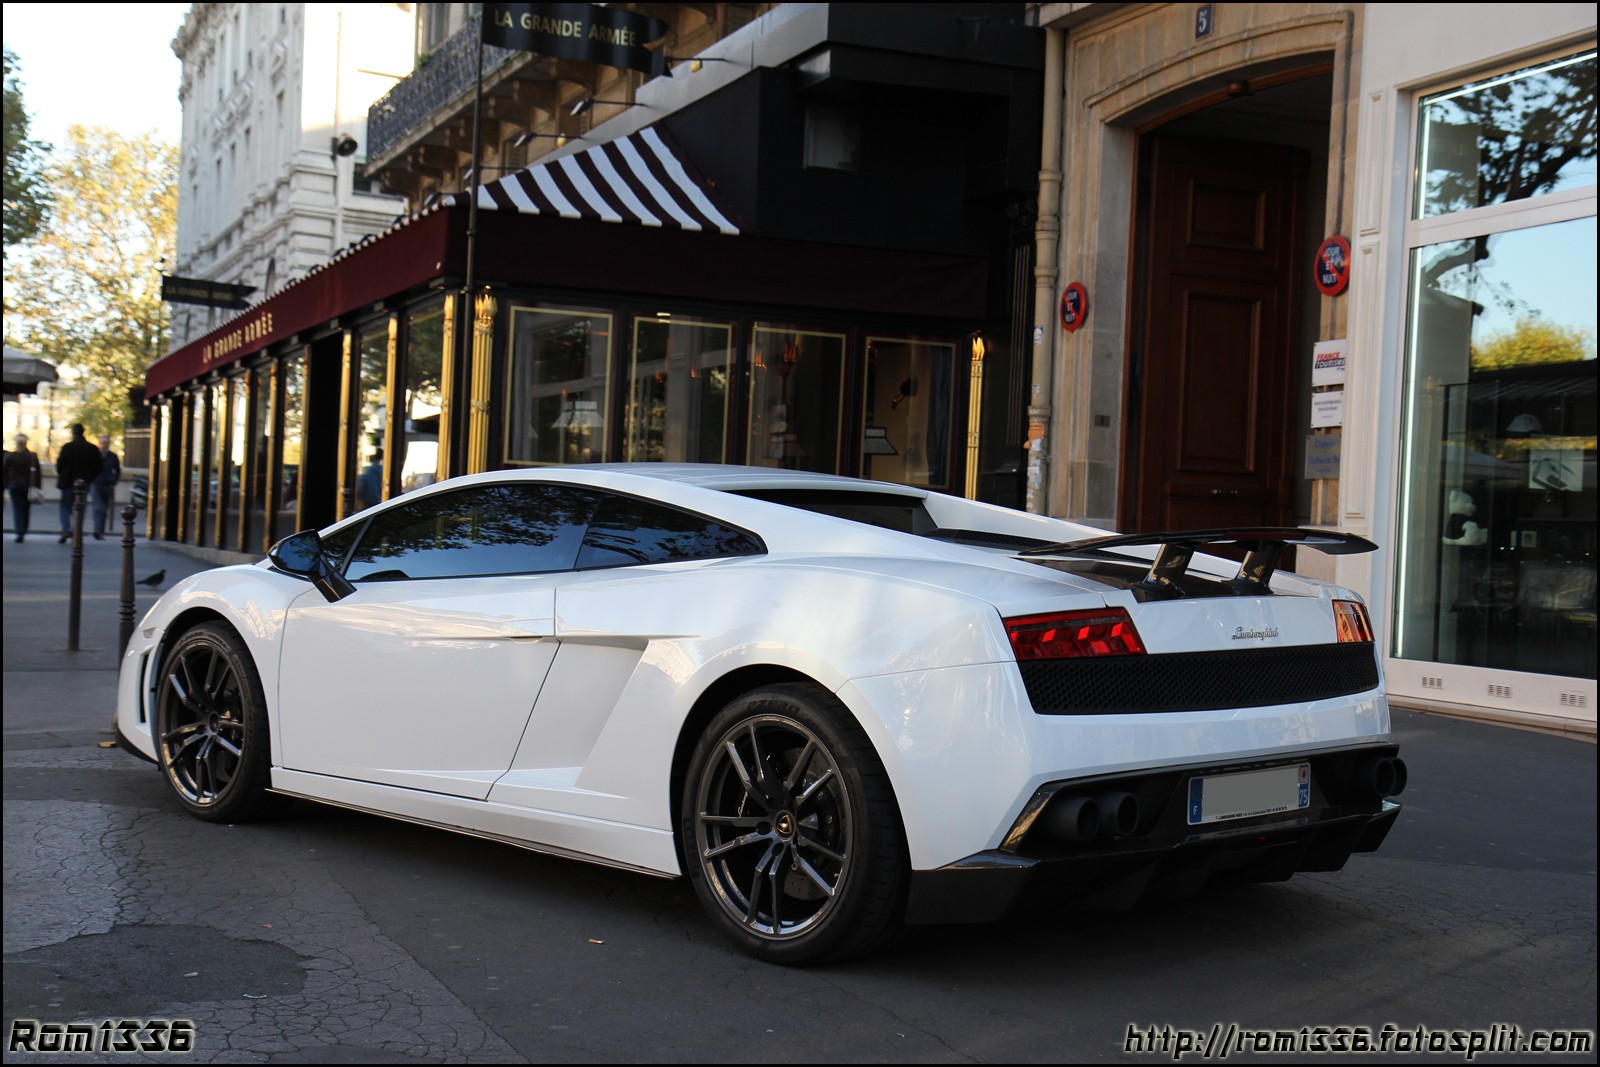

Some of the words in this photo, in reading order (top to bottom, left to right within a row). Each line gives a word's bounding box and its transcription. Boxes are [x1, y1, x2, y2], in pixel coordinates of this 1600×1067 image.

[495, 9, 514, 28] LA
[520, 12, 582, 38] GRANDE
[588, 24, 637, 47] ARMÉE
[1198, 10, 1208, 33] 5
[1322, 273, 1337, 285] NUIT
[203, 344, 212, 364] LA
[214, 329, 242, 359] GRANDE
[245, 311, 273, 344] ARMÉE
[1317, 351, 1340, 361] FRANCE
[1299, 789, 1308, 804] 75
[1193, 805, 1198, 815] F
